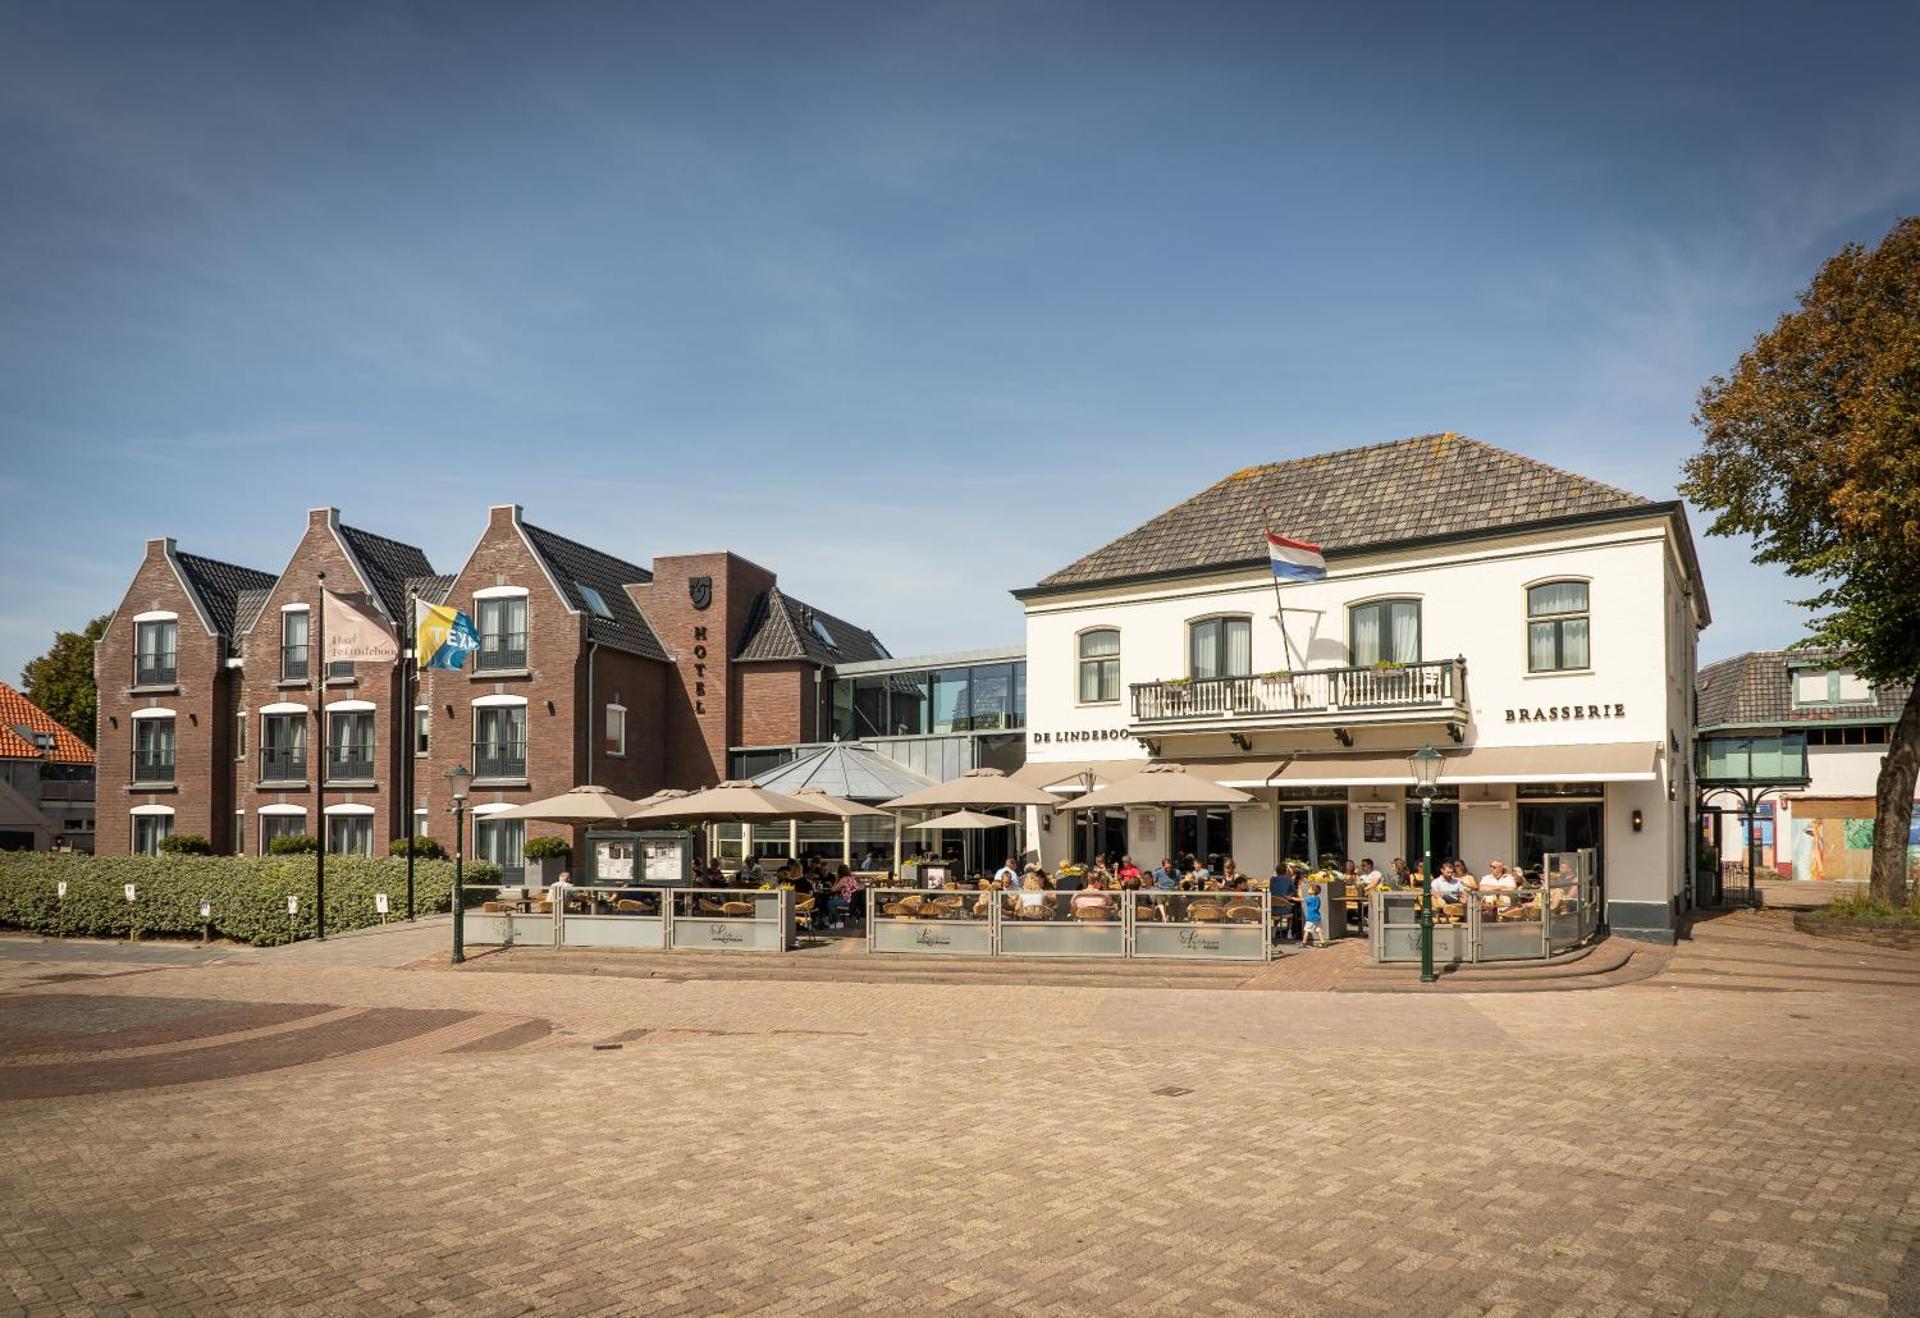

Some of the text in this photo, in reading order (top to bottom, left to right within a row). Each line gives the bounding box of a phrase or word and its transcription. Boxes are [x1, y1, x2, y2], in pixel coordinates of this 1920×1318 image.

[694, 626, 707, 714] HOTEL
[1505, 704, 1625, 723] BRASSERIE
[1034, 729, 1130, 743] DE LINDEBOO
